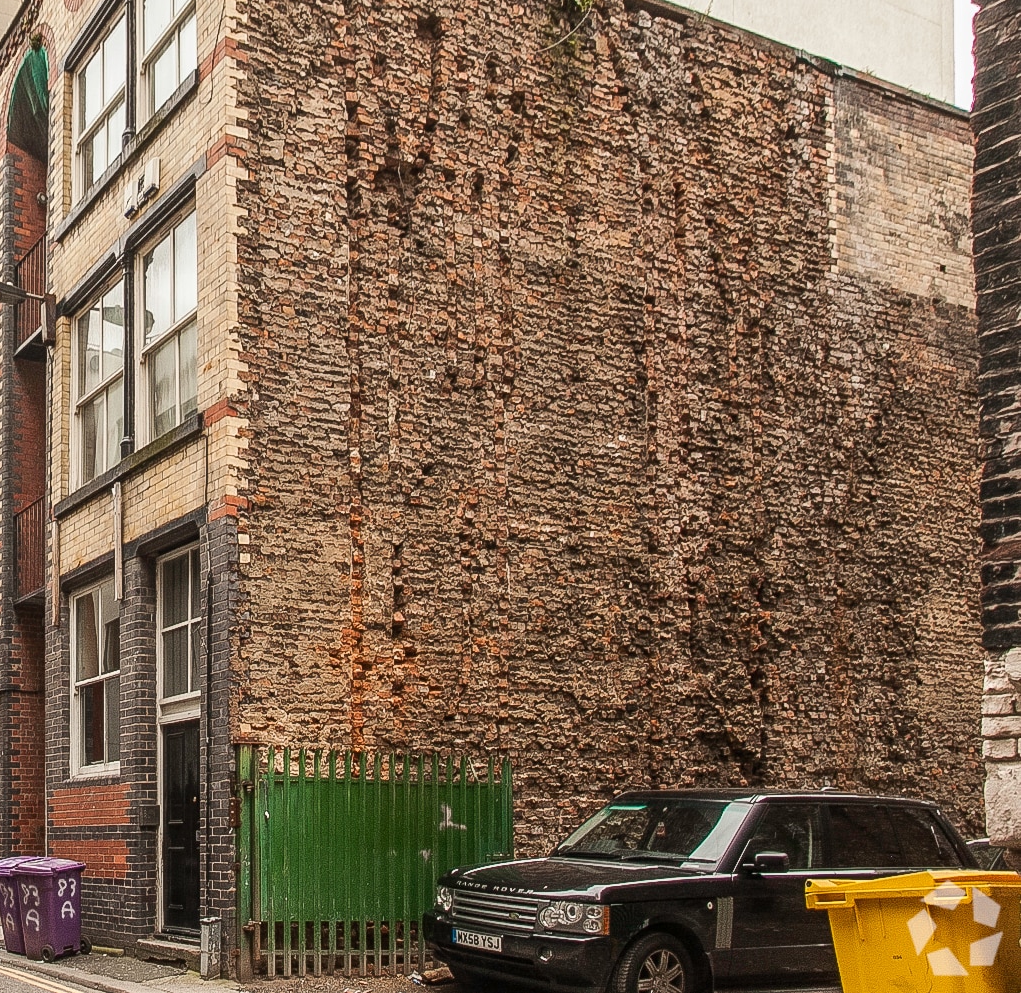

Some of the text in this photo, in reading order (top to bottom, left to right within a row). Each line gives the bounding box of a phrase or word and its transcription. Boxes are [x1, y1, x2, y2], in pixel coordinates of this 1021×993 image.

[21, 883, 40, 907] 83
[57, 878, 77, 898] 83
[61, 900, 75, 919] A
[25, 908, 40, 932] A
[481, 936, 500, 950] YSJ
